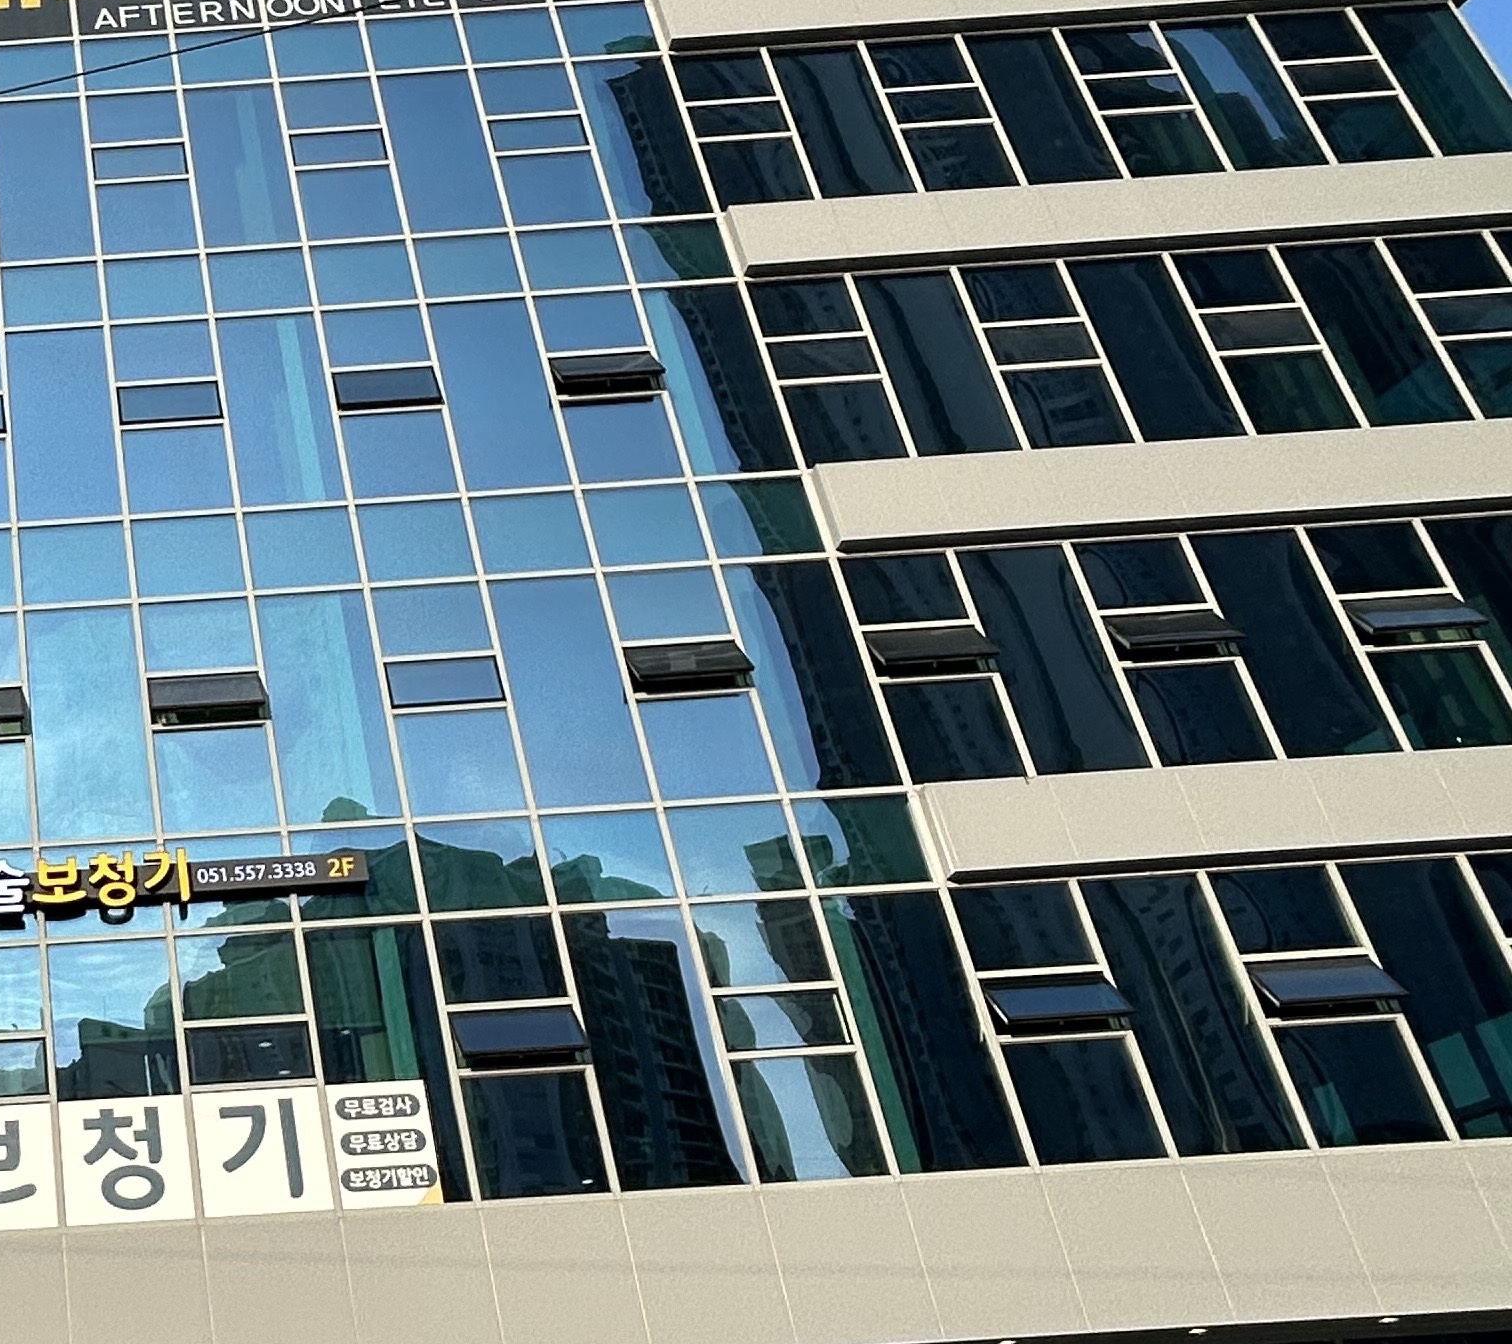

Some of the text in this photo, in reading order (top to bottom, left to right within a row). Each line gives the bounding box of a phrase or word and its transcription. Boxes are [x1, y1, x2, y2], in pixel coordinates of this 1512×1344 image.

[197, 861, 316, 886] 051.557.3338
[327, 856, 354, 879] 2F
[344, 1096, 412, 1118] 무료검사
[349, 1131, 418, 1153] 무료상담
[349, 1166, 430, 1189] 보청기할인
